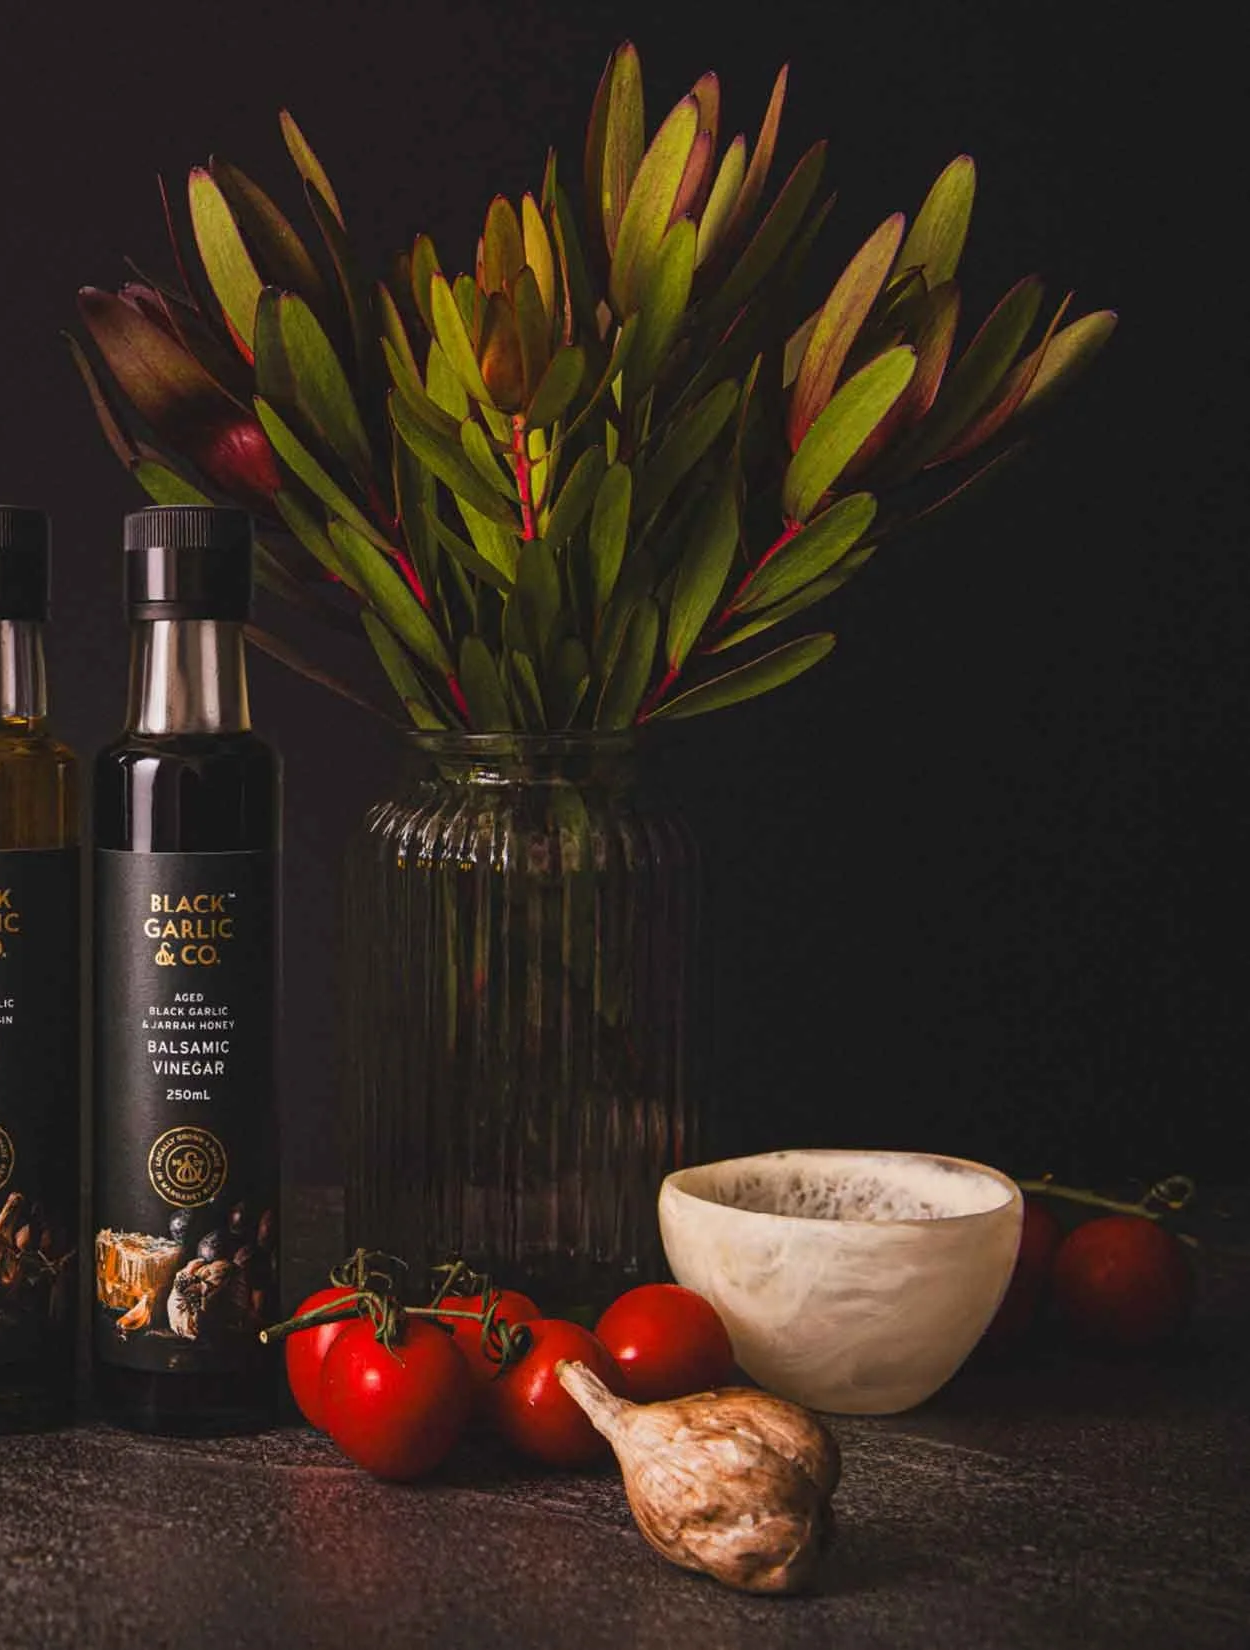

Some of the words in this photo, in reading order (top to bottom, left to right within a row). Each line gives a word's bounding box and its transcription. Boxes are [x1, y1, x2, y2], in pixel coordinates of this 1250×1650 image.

[143, 919, 234, 939] GARLIC
[154, 942, 177, 966] &
[180, 944, 221, 966] CO.
[174, 993, 204, 1002] AGED
[149, 1006, 185, 1016] BLACK
[188, 1006, 229, 1016] GARLIC
[150, 1020, 196, 1030] JARRAH
[199, 1020, 235, 1030] HONEY
[147, 1040, 230, 1054] BALSAMIC
[152, 1060, 225, 1075] VINEGAR
[166, 1089, 211, 1100] 250mL
